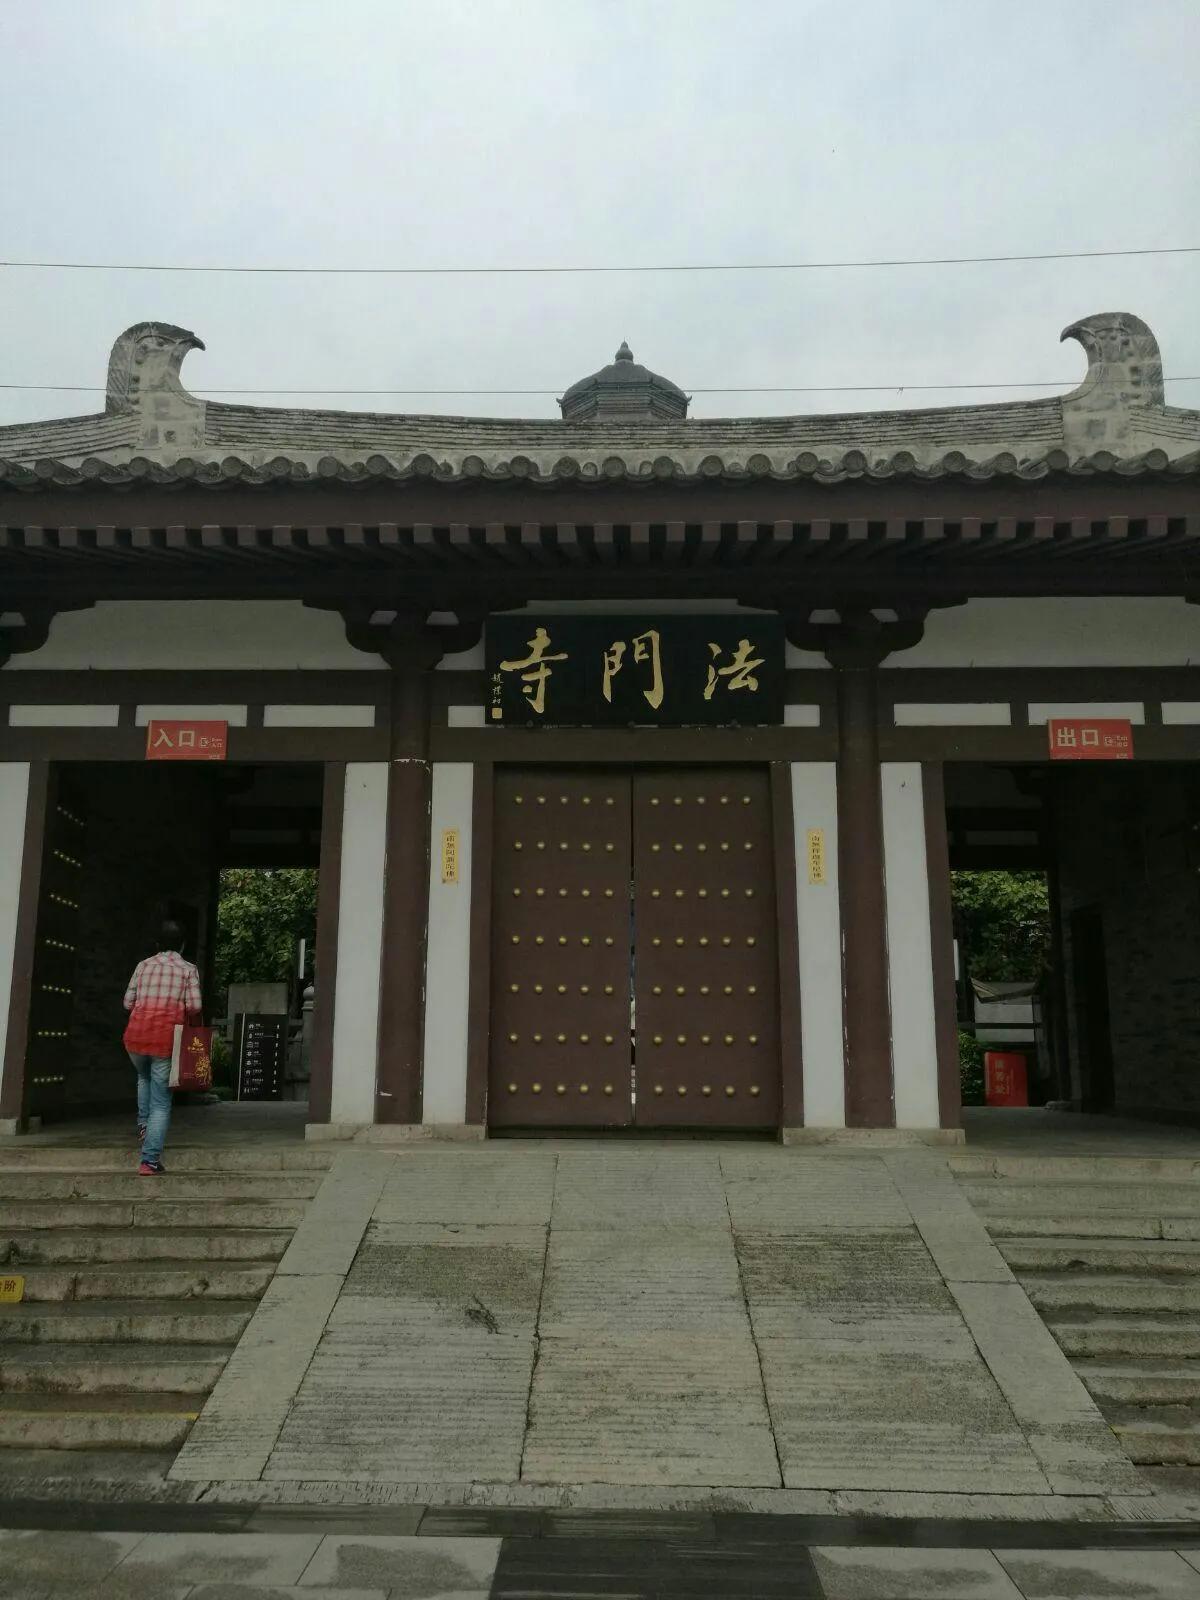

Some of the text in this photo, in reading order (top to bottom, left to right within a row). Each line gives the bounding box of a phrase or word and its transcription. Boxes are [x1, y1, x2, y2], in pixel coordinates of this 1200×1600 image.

[500, 628, 765, 713] 法門寺
[154, 728, 195, 748] 入口
[1057, 727, 1099, 747] 出口
[0, 1279, 17, 1293] 阶
